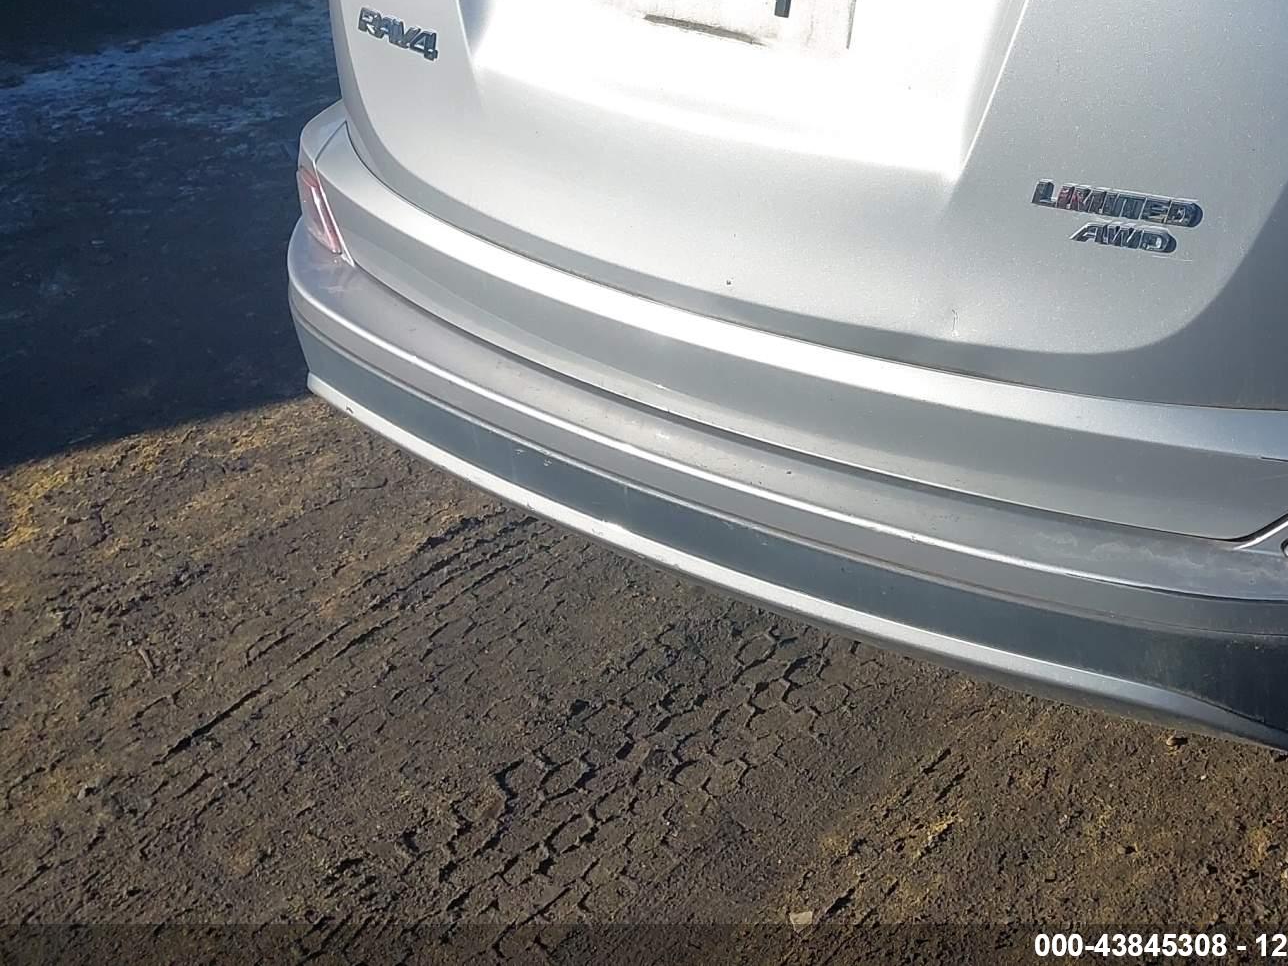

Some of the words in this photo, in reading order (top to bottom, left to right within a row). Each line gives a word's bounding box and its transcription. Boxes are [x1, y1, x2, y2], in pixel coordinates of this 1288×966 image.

[358, 7, 439, 61] RAV4
[1031, 180, 1203, 227] LIMITED
[1069, 222, 1178, 254] AWD
